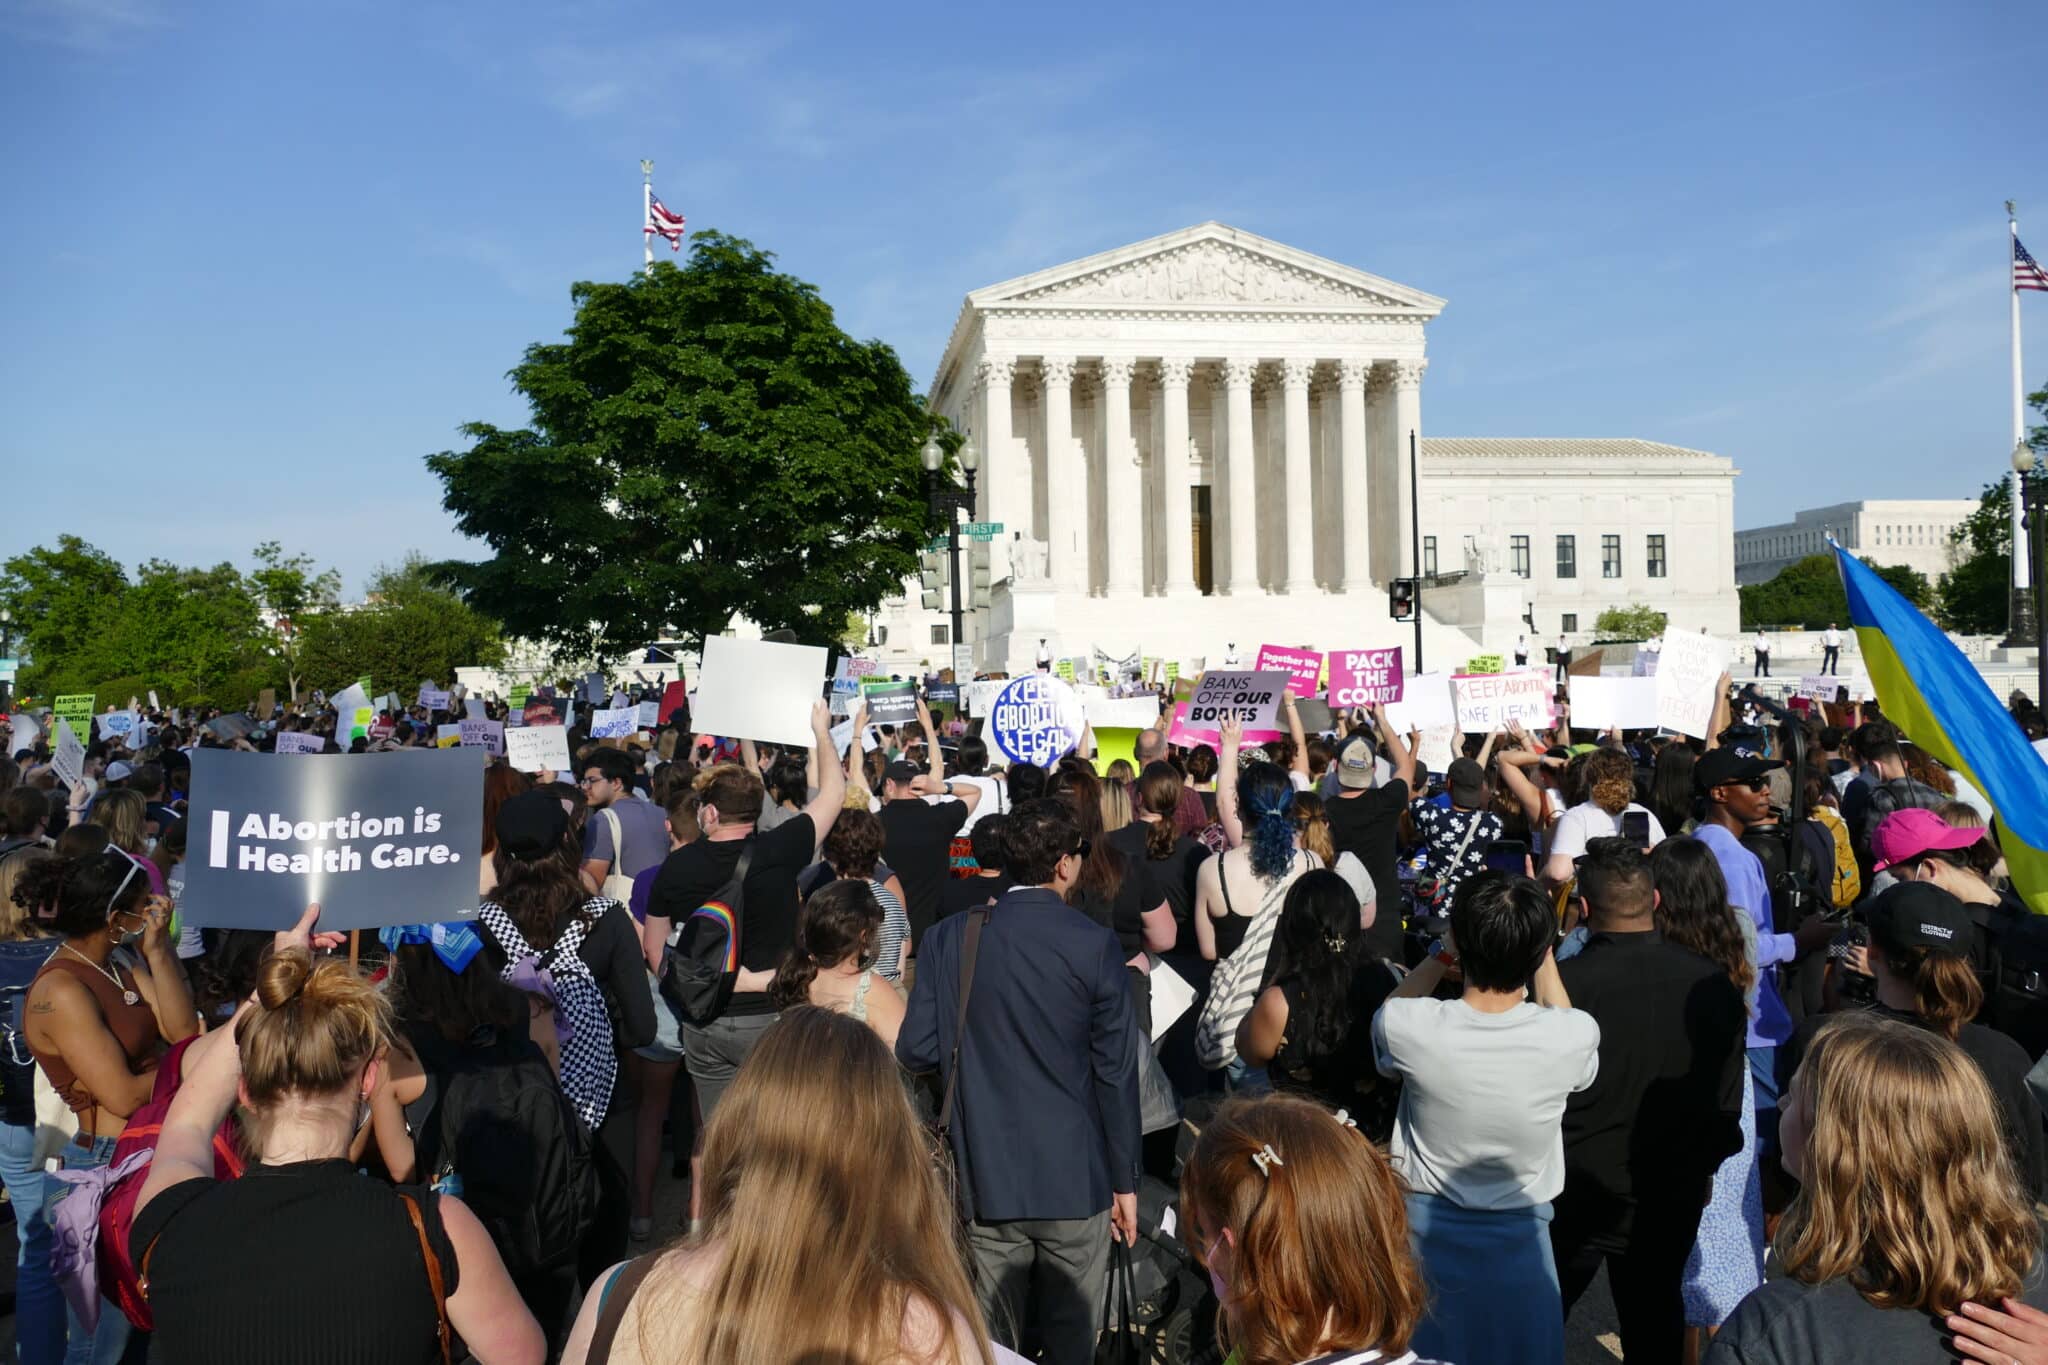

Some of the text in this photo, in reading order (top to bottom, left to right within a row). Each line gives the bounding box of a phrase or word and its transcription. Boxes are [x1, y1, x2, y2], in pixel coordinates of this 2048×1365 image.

[963, 525, 993, 533] FIRST
[847, 659, 877, 670] FORCED
[1262, 652, 1319, 669] Together We
[1345, 652, 1394, 670] PACK
[1301, 669, 1315, 679] All
[1352, 670, 1389, 687] THE
[1203, 677, 1251, 690] BANS
[1009, 680, 1057, 703] KEE
[1197, 692, 1272, 704] OFF OUR
[1337, 685, 1399, 705] COURT
[996, 701, 1066, 731] ABORTIO
[1191, 707, 1258, 722] BODIES
[1460, 706, 1489, 723] SAFE
[461, 723, 487, 732] BANS
[279, 735, 304, 744] BANS
[462, 733, 480, 741] OFF
[238, 806, 442, 841] Abortion is
[238, 842, 461, 874] Health Care.
[1920, 928, 1952, 939] CLOTHING
